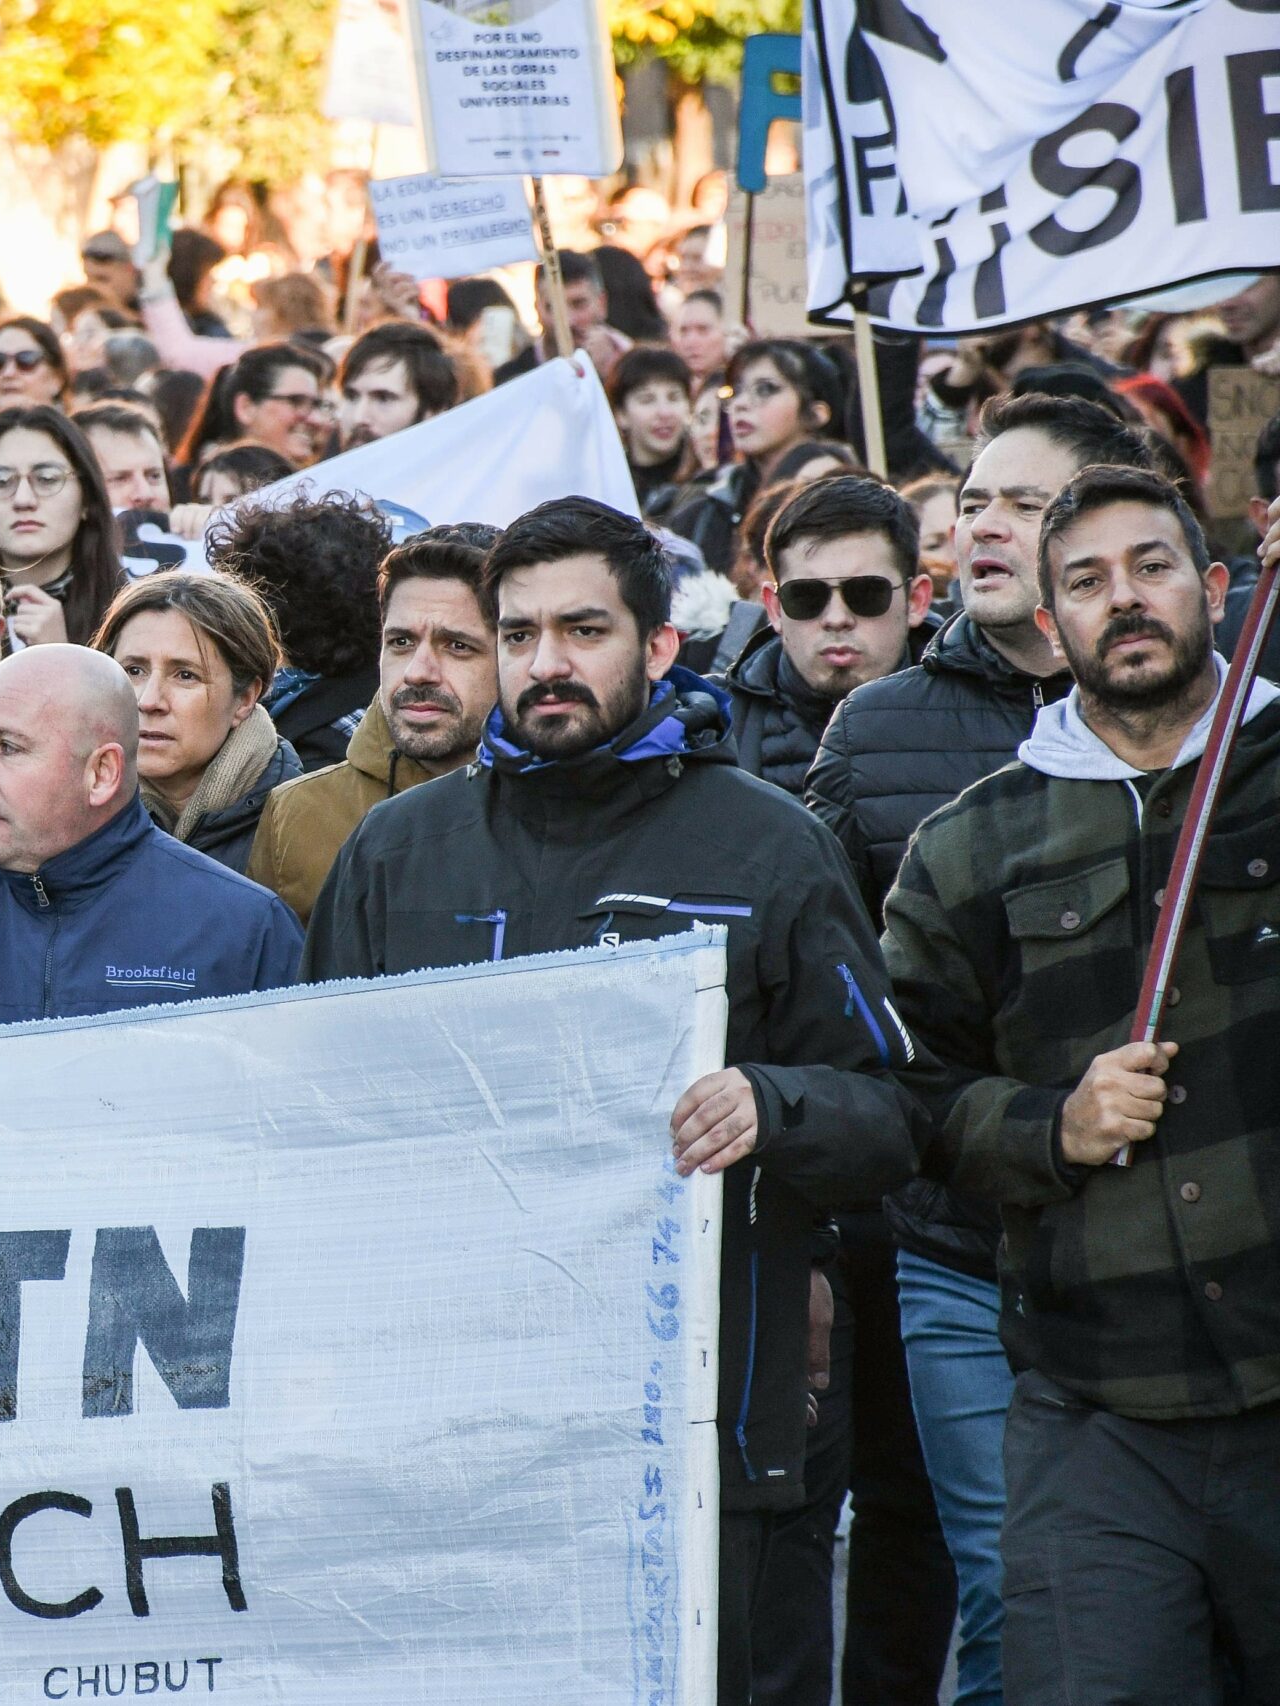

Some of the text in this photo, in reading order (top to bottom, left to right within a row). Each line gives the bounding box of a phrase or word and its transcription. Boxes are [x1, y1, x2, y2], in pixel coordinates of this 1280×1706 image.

[473, 33, 543, 44] POR EL NO
[435, 49, 580, 62] DESFINANCIAMIENTO
[463, 65, 557, 77] DE LAS OBRAS
[481, 81, 546, 91] SOCIALES
[459, 96, 570, 108] UNIVERSITARIAS
[399, 207, 425, 224] UN
[429, 193, 505, 220] DERECHO
[412, 233, 437, 250] UN
[106, 965, 196, 981] Brooksfield
[44, 1657, 223, 1700] CHUBUT
